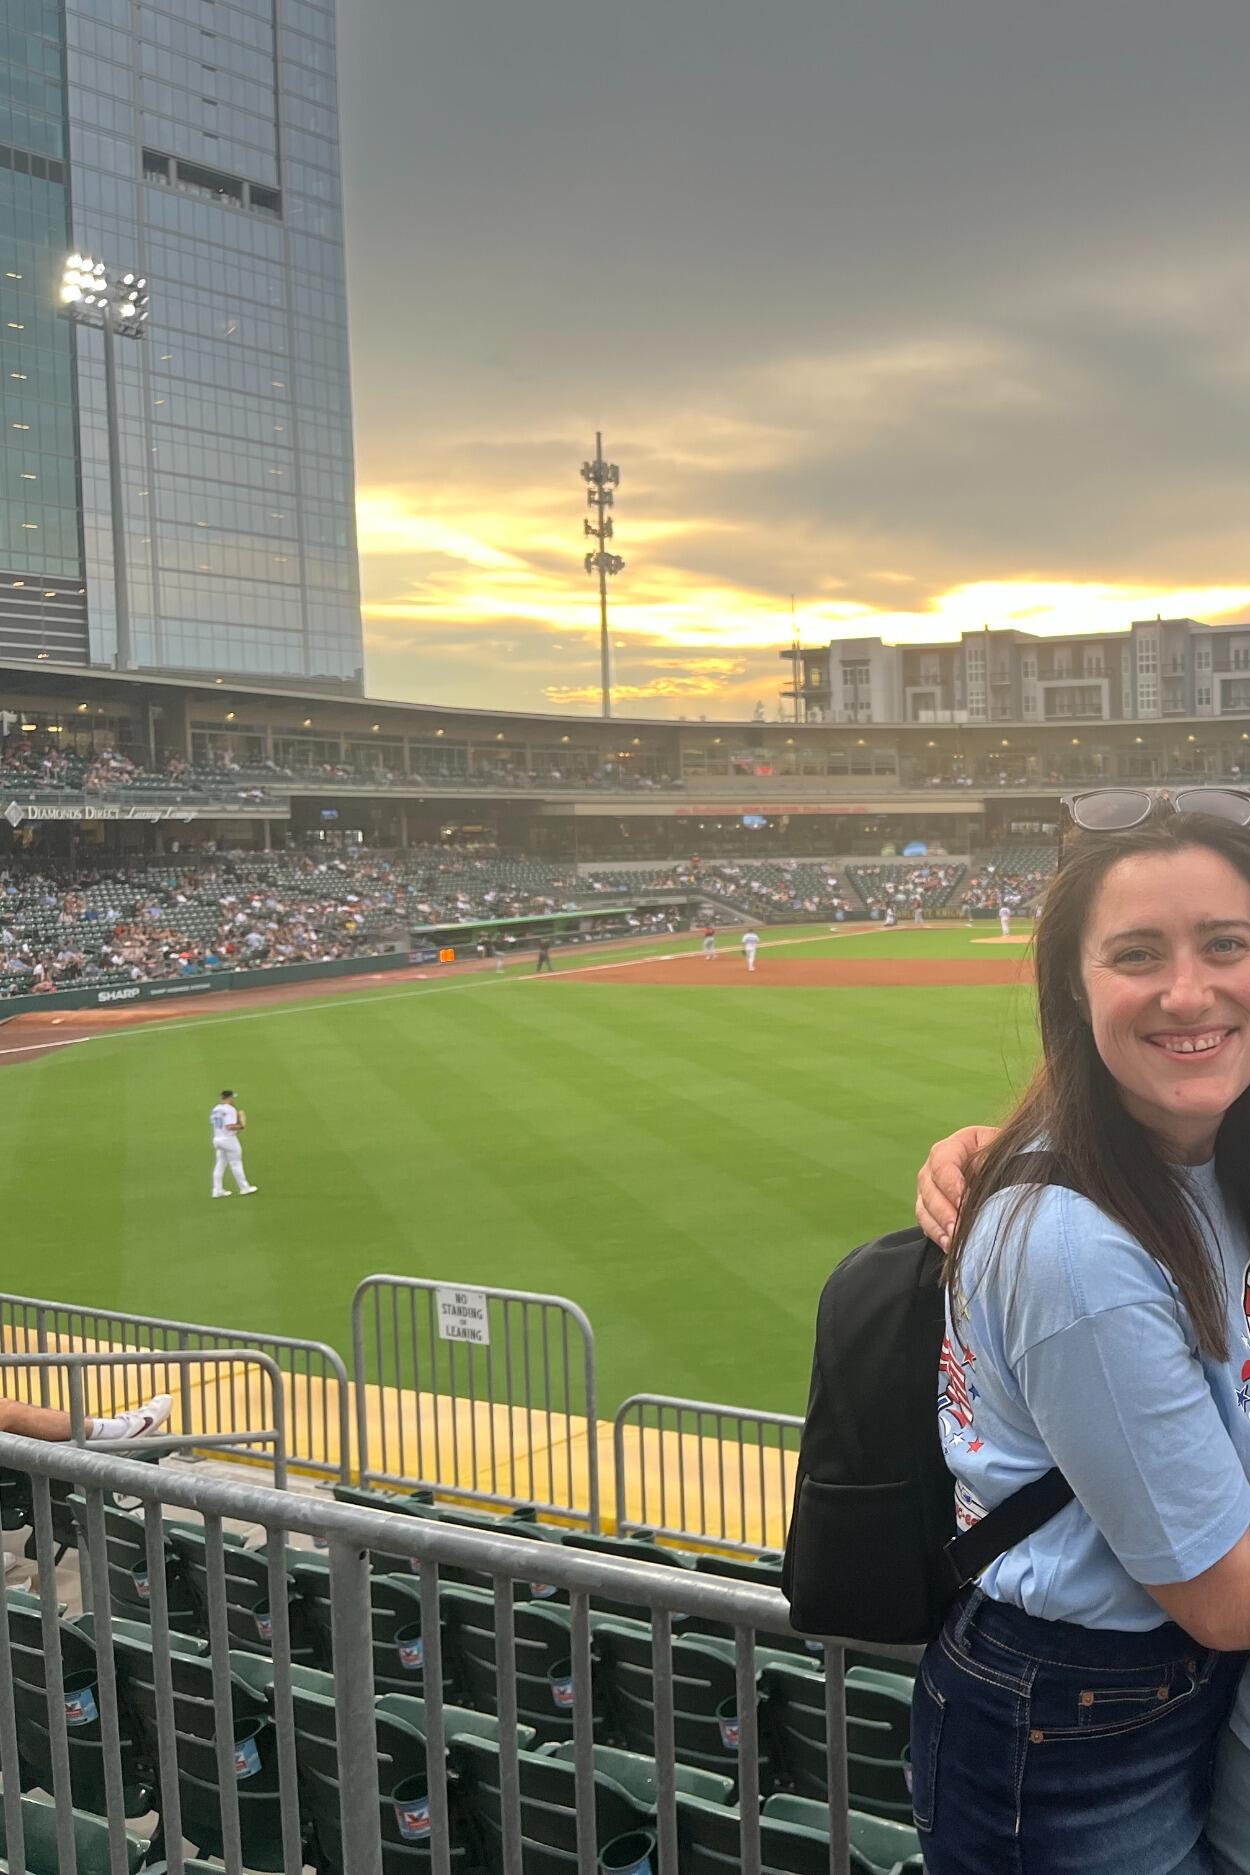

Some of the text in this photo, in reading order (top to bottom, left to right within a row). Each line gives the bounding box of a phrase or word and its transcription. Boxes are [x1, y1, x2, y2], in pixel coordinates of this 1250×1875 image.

[28, 805, 82, 820] DIAMONDS
[85, 805, 119, 820] DIRECT
[98, 988, 140, 1002] SHARP
[455, 1293, 467, 1305] NO
[442, 1303, 483, 1320] STANDING
[446, 1325, 482, 1341] LEANING
